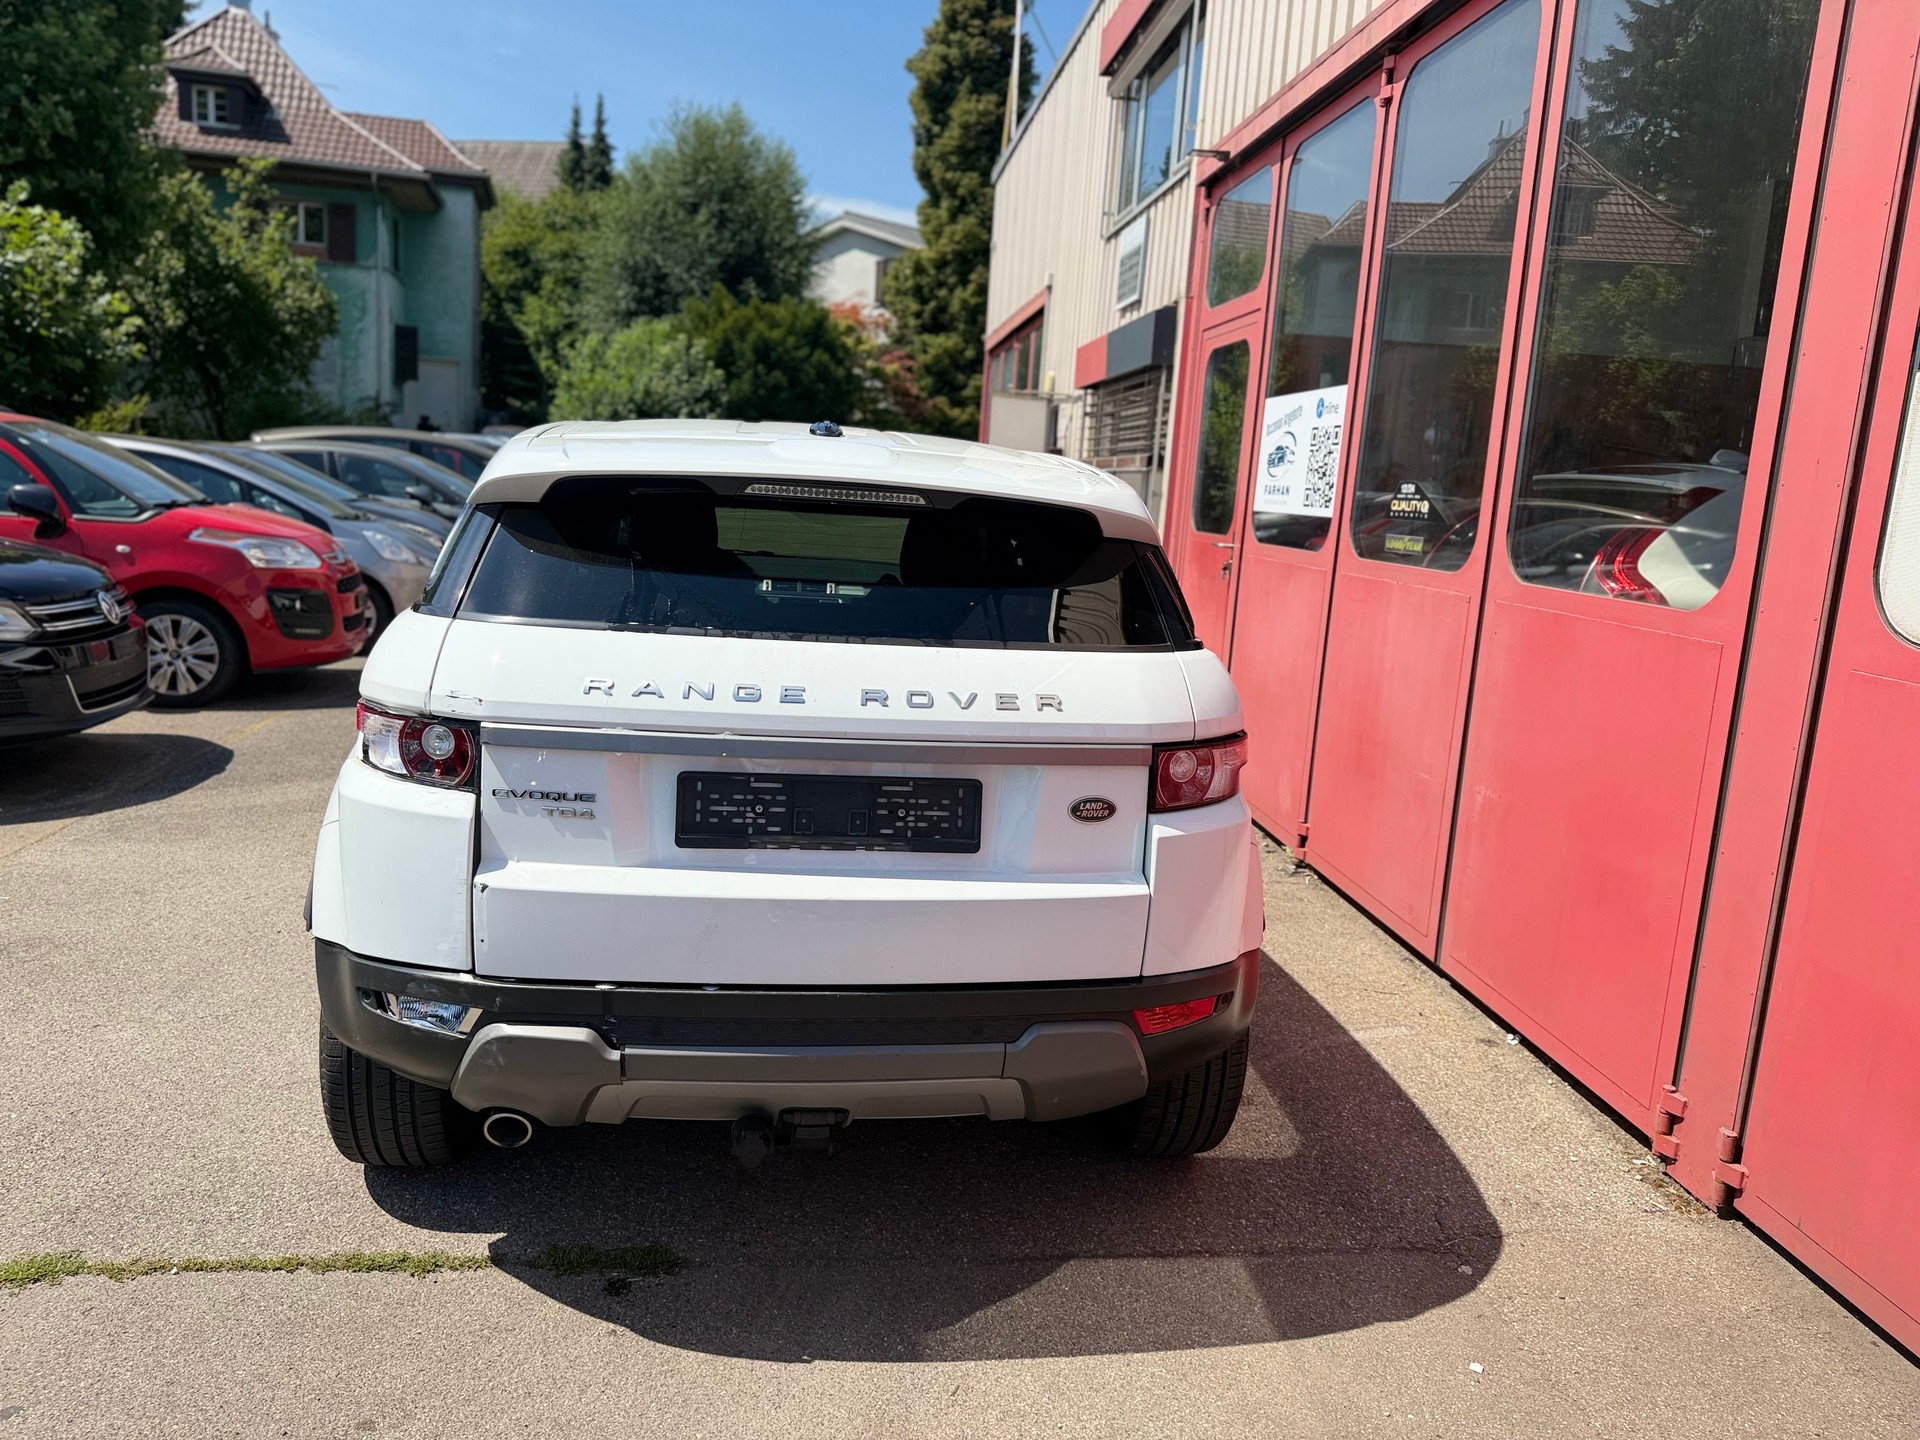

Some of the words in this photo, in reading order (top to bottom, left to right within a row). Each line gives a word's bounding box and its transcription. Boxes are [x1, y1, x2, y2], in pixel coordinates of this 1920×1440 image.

[1264, 484, 1290, 496] FARHAN
[583, 676, 806, 704] RANGE
[860, 688, 1064, 712] ROVER
[491, 787, 597, 803] EVOQUE
[541, 805, 596, 820] TD4
